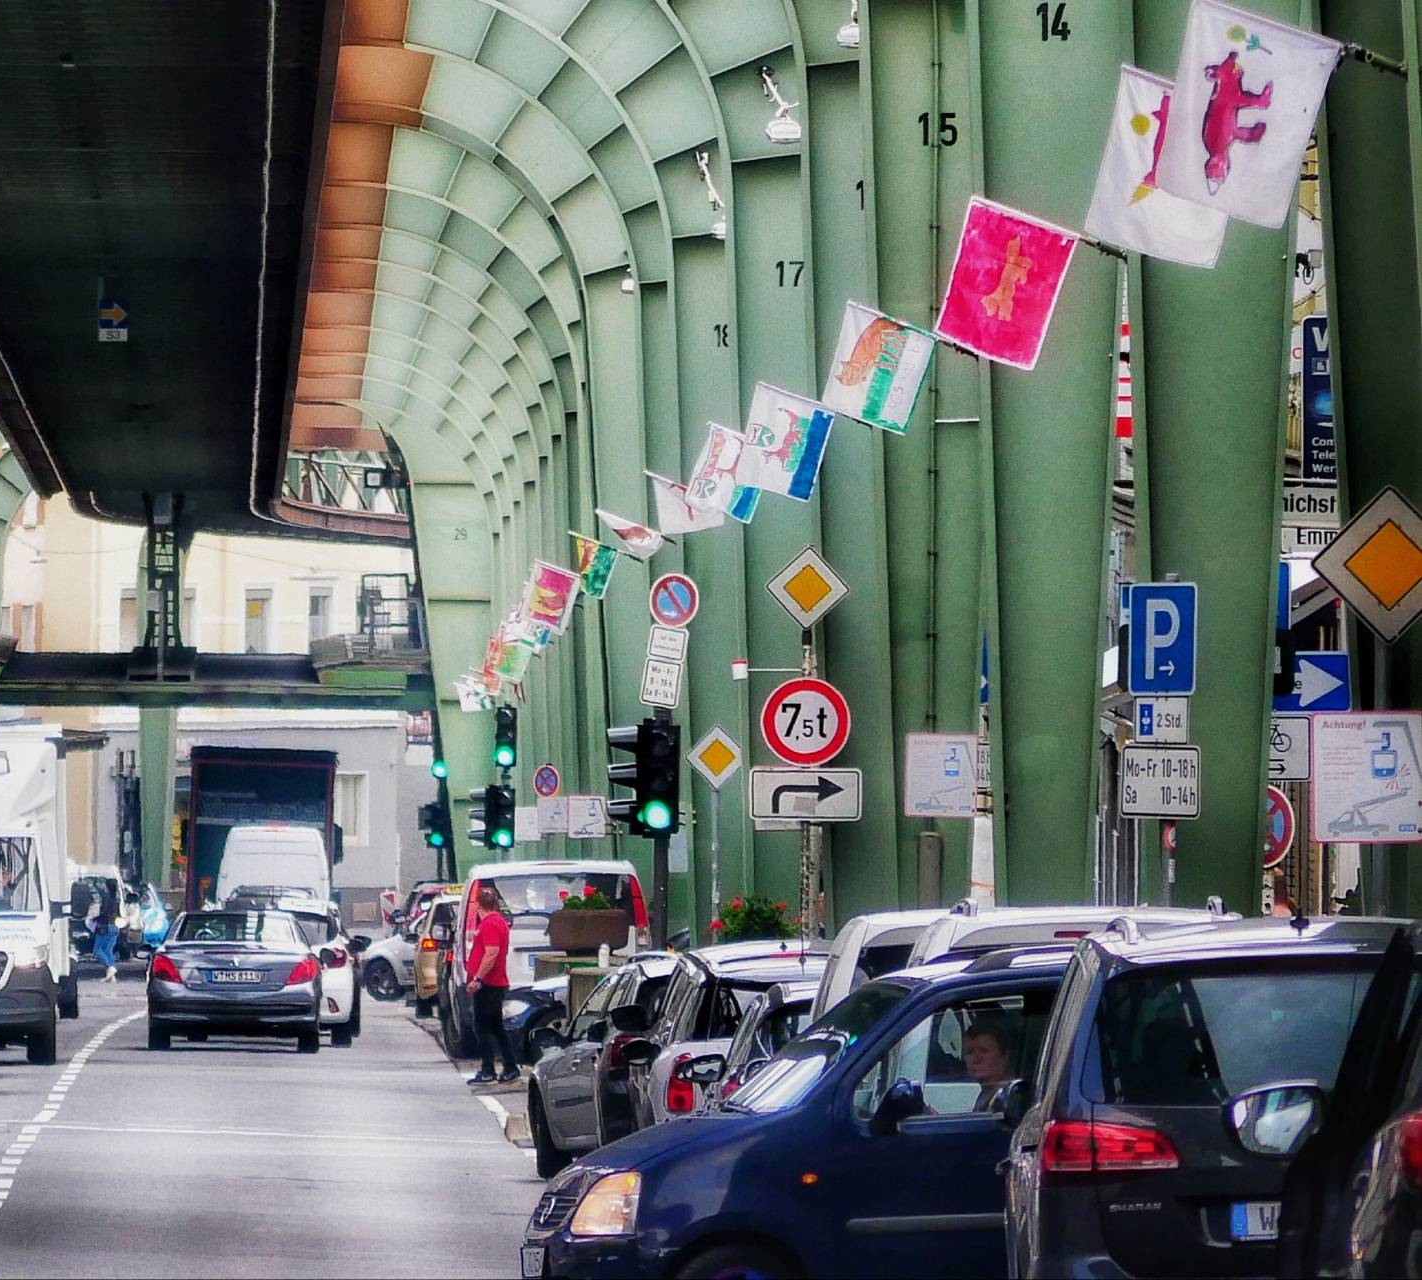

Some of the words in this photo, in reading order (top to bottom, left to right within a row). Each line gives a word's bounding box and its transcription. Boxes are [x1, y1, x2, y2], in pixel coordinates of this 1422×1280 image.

[1036, 2, 1071, 41] 14
[918, 112, 958, 146] 15
[776, 261, 805, 287] 17
[1144, 598, 1181, 680] P
[1125, 785, 1138, 804] Sa
[1109, 1202, 1162, 1213] SHARAN
[1259, 1206, 1276, 1231] W
